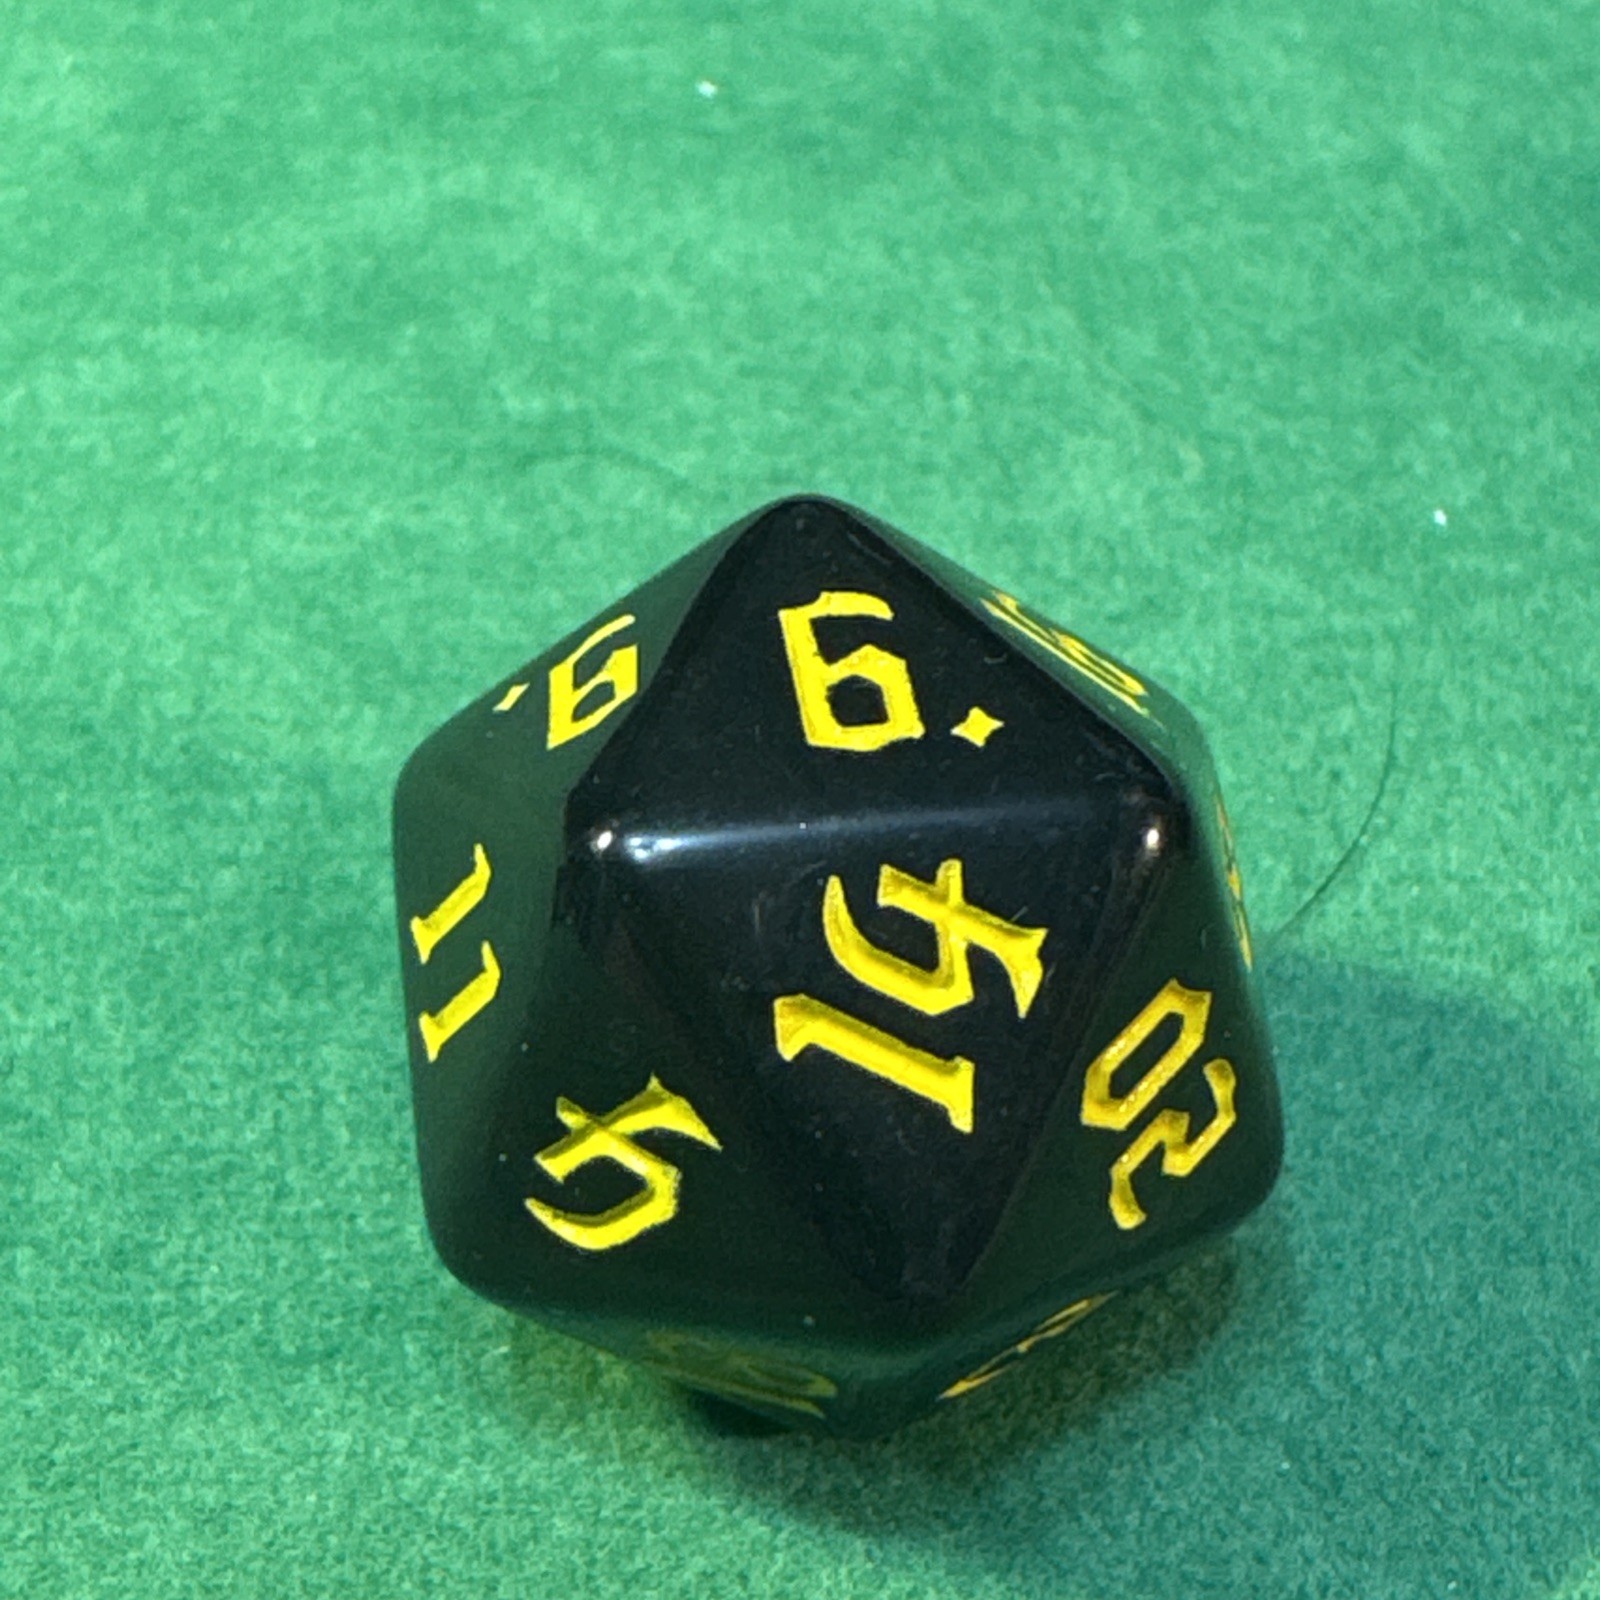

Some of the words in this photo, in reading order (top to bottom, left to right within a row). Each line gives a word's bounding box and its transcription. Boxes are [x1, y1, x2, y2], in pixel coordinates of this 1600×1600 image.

[411, 843, 501, 1063] 11
[774, 859, 1048, 1133] 14
[524, 1073, 722, 1250] 4
[1080, 978, 1237, 1230] 20
